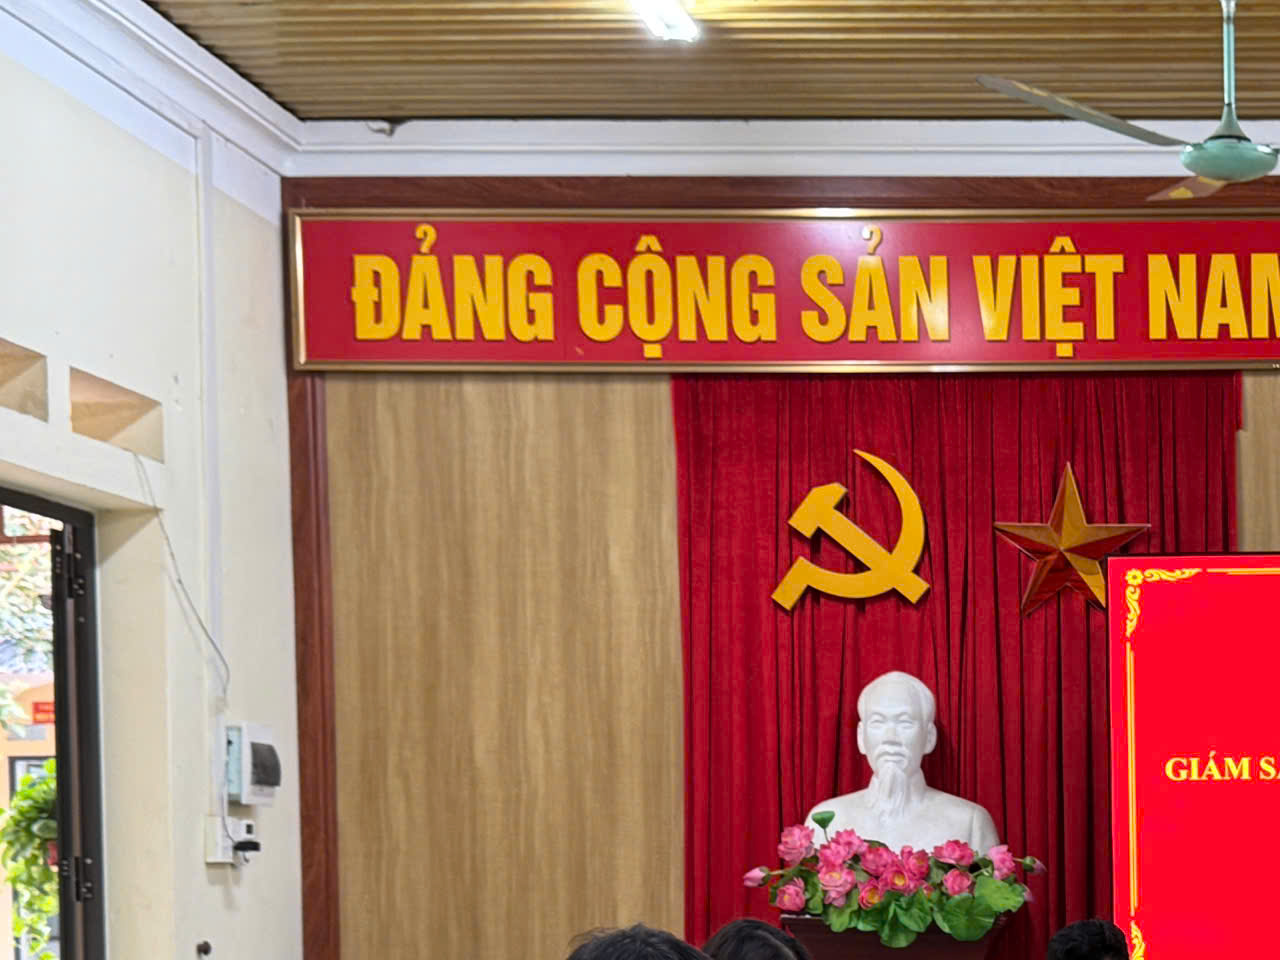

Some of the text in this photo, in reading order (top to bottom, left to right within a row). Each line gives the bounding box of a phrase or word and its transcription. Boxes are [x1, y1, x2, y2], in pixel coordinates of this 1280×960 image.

[351, 223, 555, 342] ĐẢNG
[576, 234, 777, 359] CỘNG
[799, 224, 950, 342] SẢN
[971, 236, 1124, 357] VIỆT
[1164, 750, 1250, 781] GIÁM
